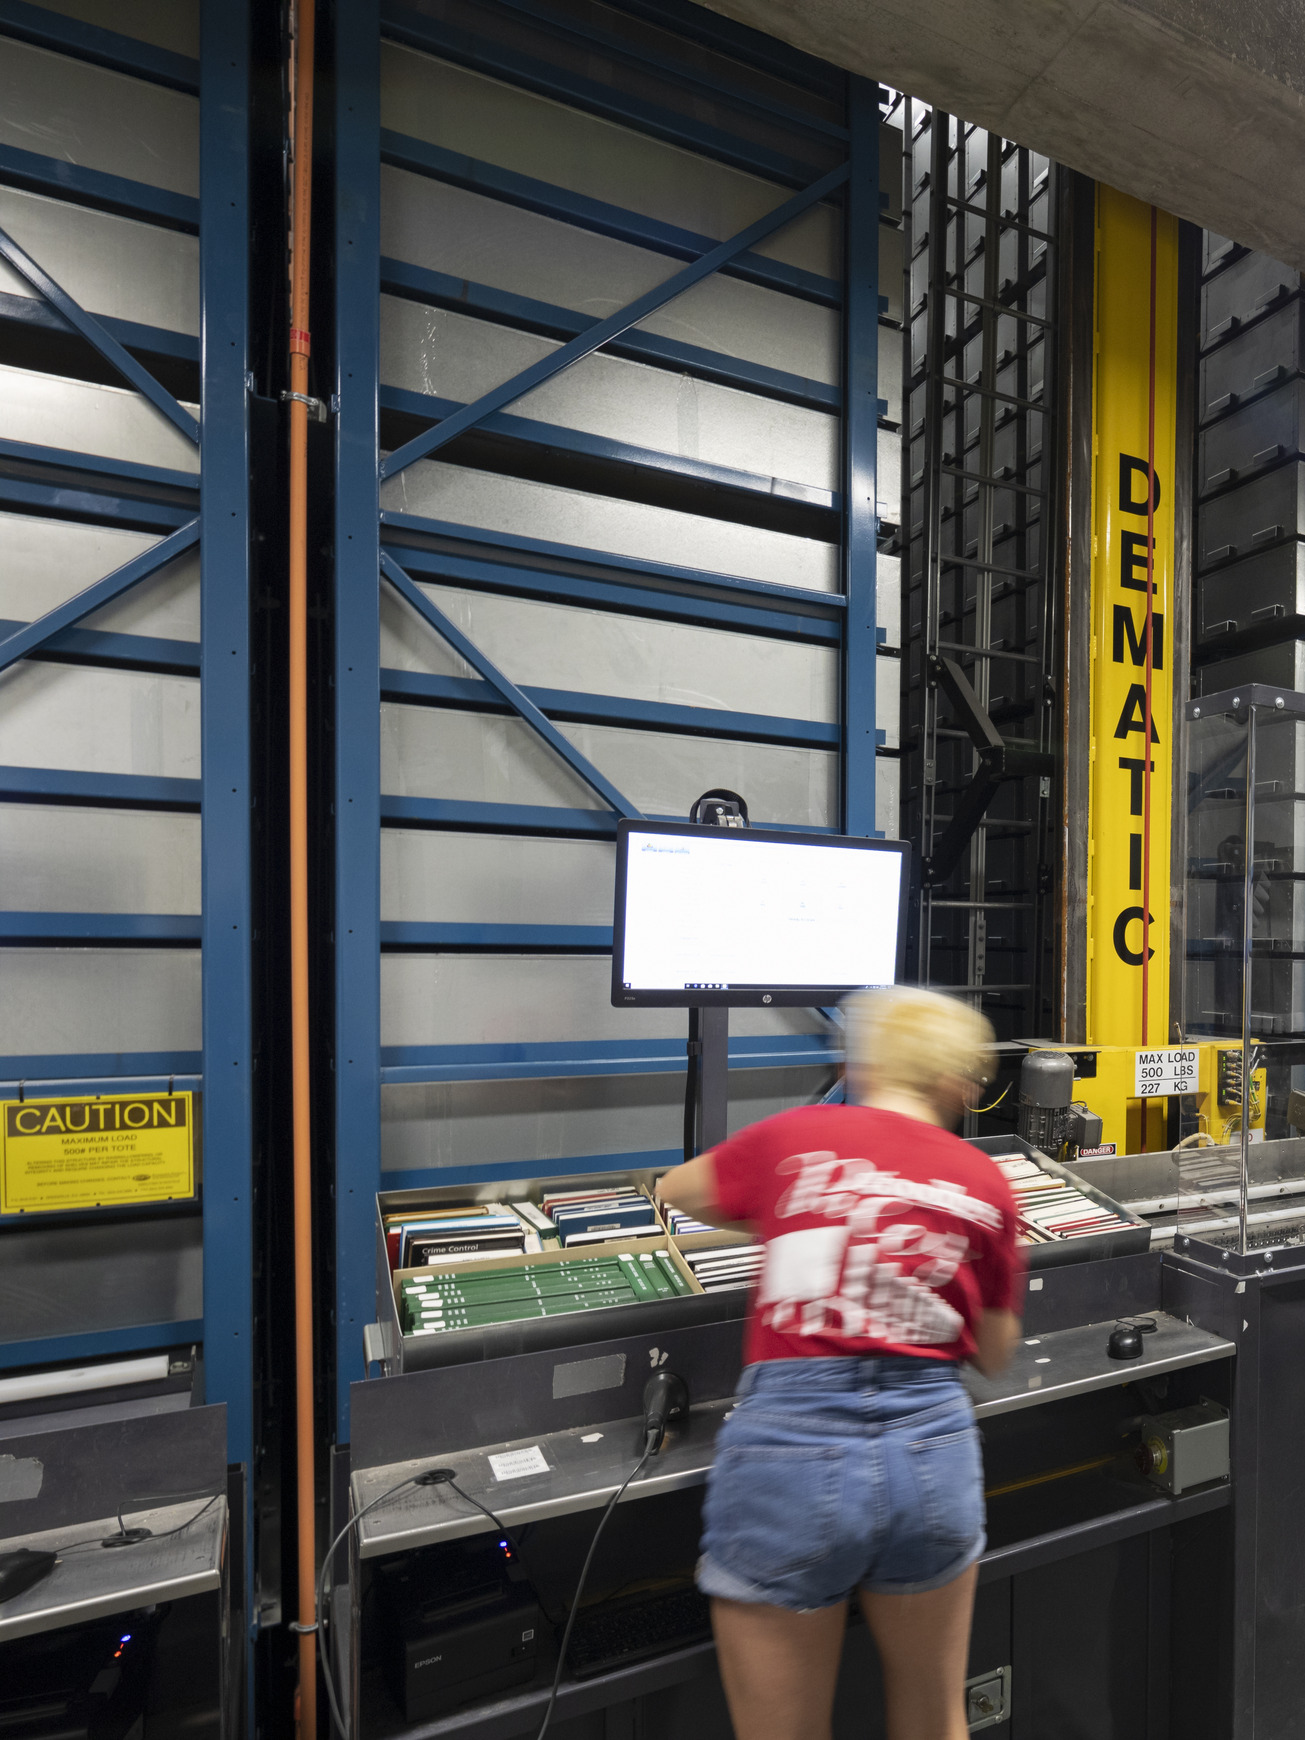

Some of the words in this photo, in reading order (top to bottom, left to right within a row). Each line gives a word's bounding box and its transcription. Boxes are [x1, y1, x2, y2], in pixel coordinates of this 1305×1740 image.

[1112, 452, 1165, 967] DEMATIC
[1139, 1053, 1163, 1065] MAX
[1167, 1051, 1196, 1063] LOAD
[1141, 1066, 1163, 1079] 500
[1174, 1064, 1194, 1076] LBS
[1140, 1082, 1161, 1094] 227
[1173, 1080, 1188, 1092] KG
[15, 1100, 176, 1134] CAUTION
[61, 1136, 109, 1145] MAXIMUM
[111, 1134, 138, 1142] LOAD
[88, 1146, 109, 1154] PER
[110, 1144, 137, 1152] TOTE
[1083, 1146, 1112, 1155] DANGER
[422, 1246, 446, 1256] Crime
[448, 1244, 479, 1253] Control
[414, 1654, 443, 1669] EPSON
